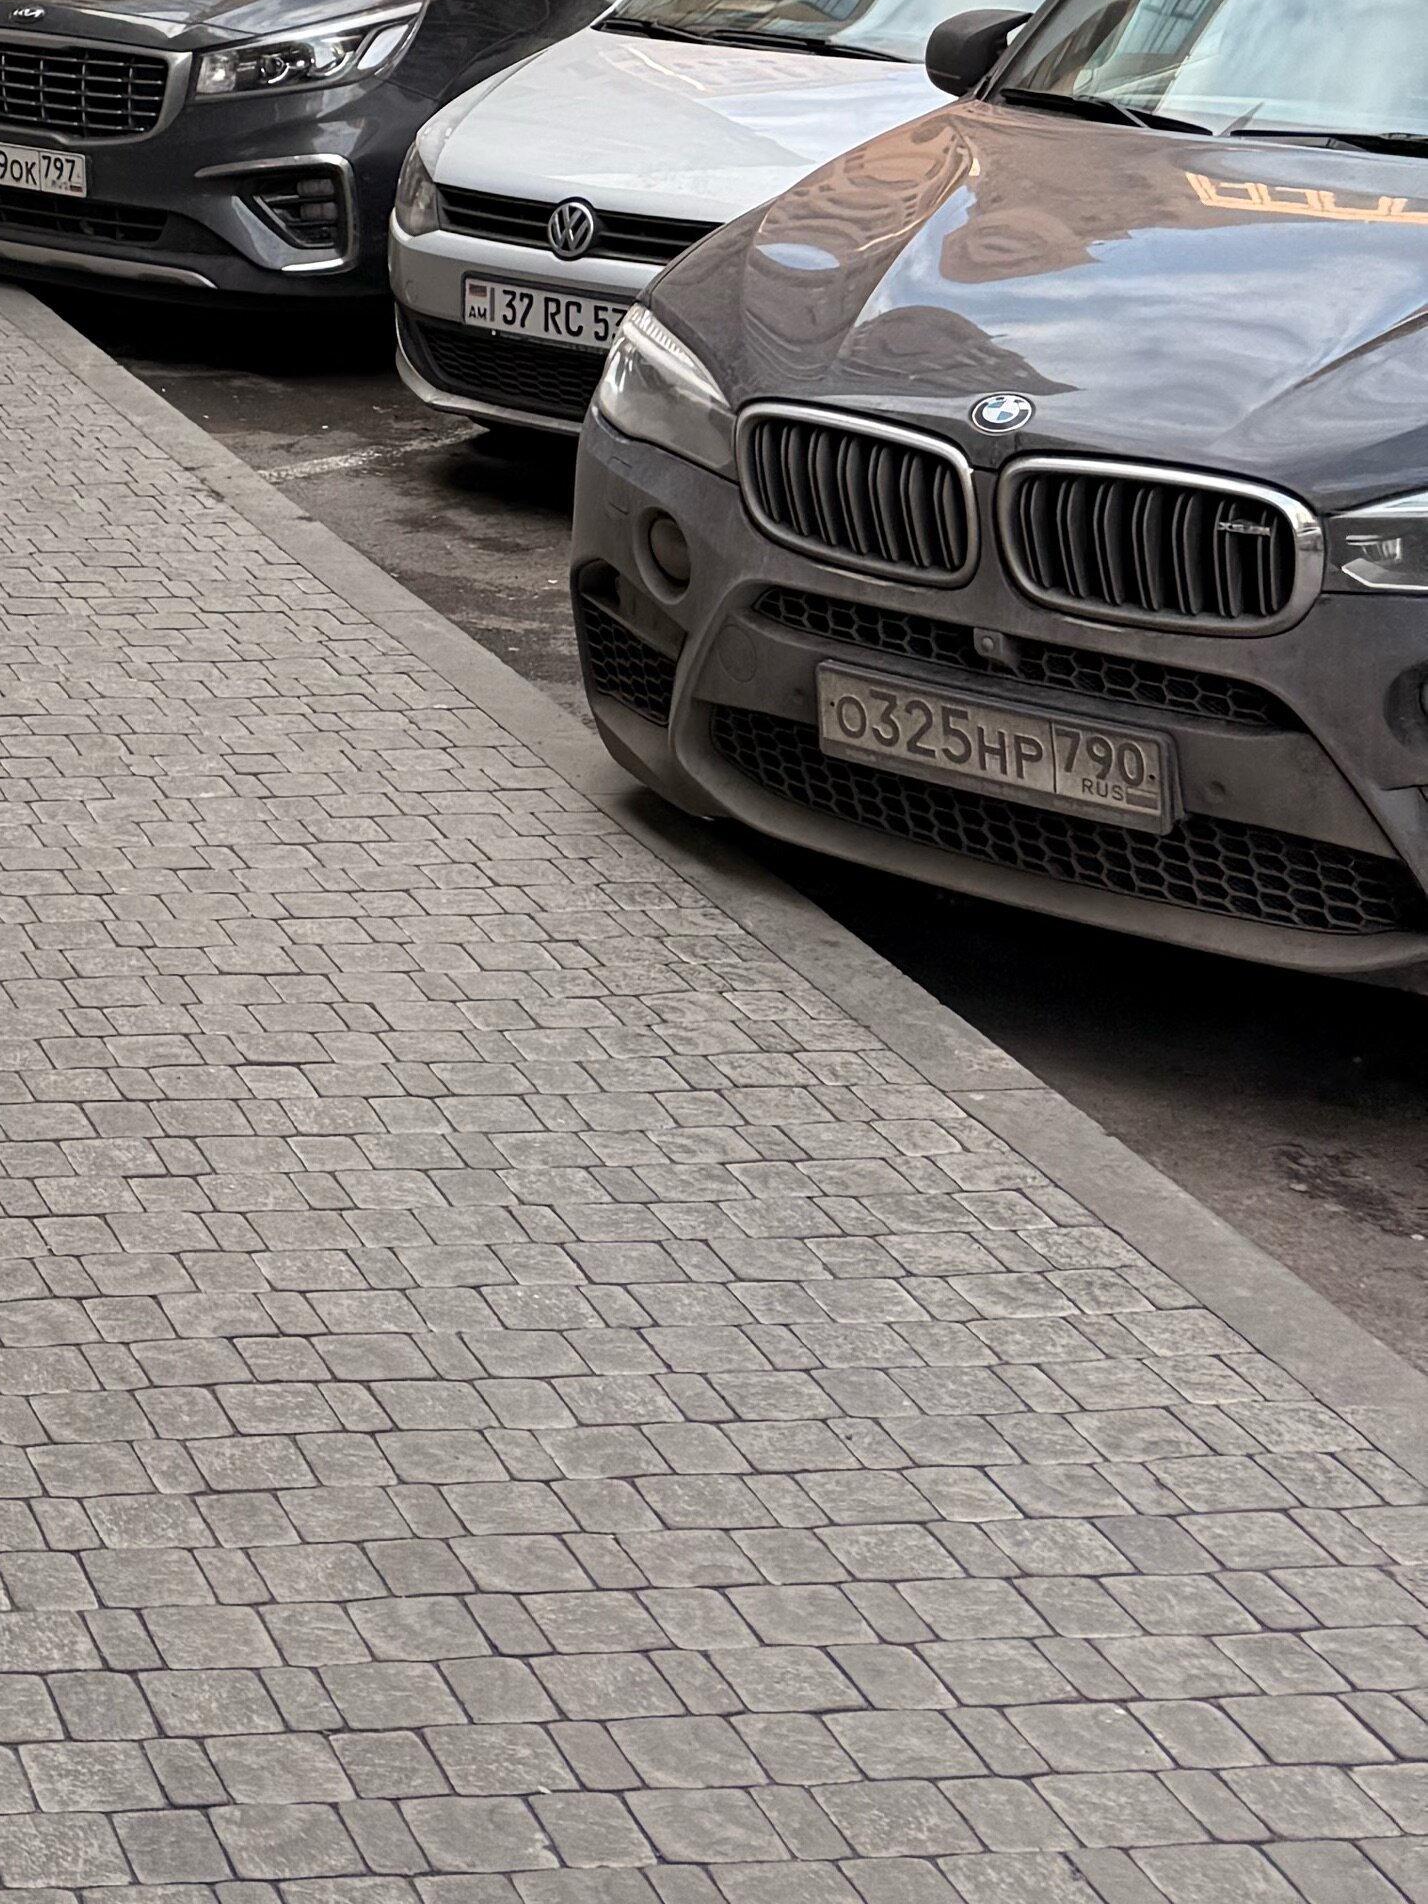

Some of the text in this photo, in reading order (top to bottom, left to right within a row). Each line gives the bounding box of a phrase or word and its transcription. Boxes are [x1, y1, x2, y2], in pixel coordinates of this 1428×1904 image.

[41, 155, 76, 182] 797
[469, 305, 487, 321] AM
[502, 289, 534, 329] 37
[544, 296, 584, 338] RC
[1056, 726, 1147, 788] 790
[1081, 777, 1125, 803] RUS
